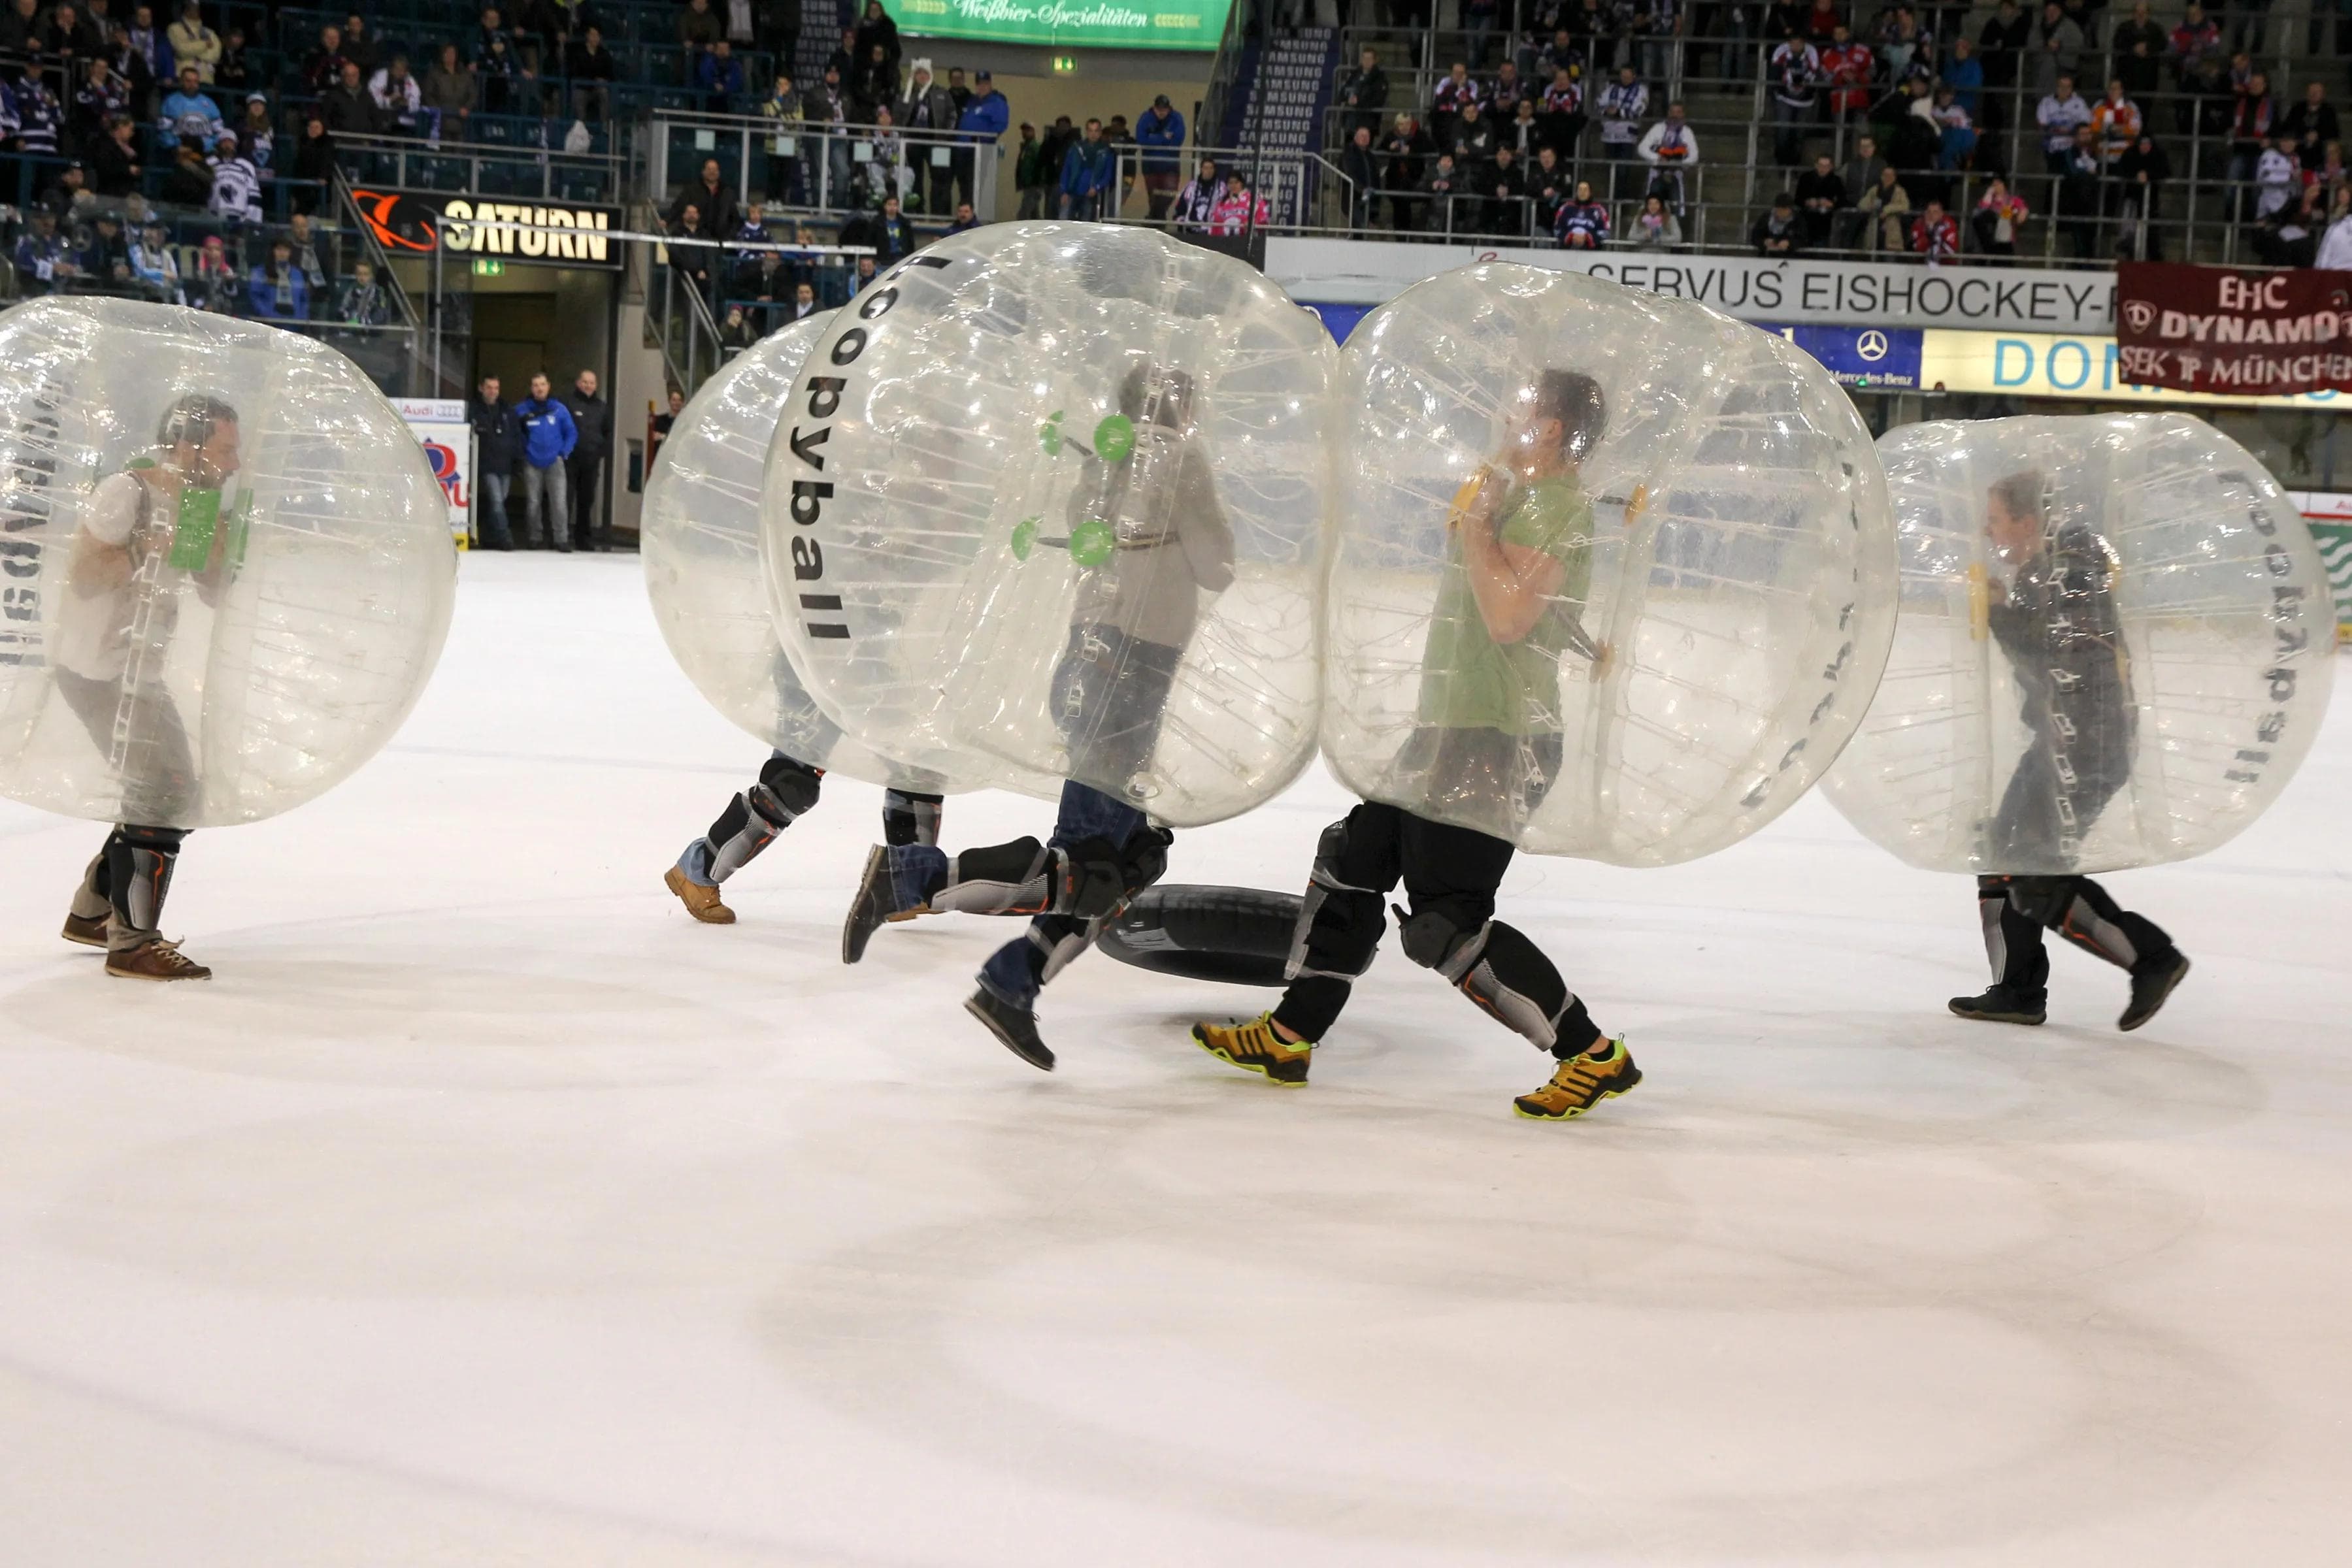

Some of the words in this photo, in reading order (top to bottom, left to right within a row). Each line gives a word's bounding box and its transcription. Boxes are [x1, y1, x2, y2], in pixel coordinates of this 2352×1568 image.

[444, 199, 608, 261] SATURN
[2219, 275, 2288, 311] EHC
[2160, 309, 2340, 344] DYNAMO
[2120, 345, 2170, 378] SEK
[403, 404, 433, 416] Audi
[790, 255, 952, 639] Loopyball
